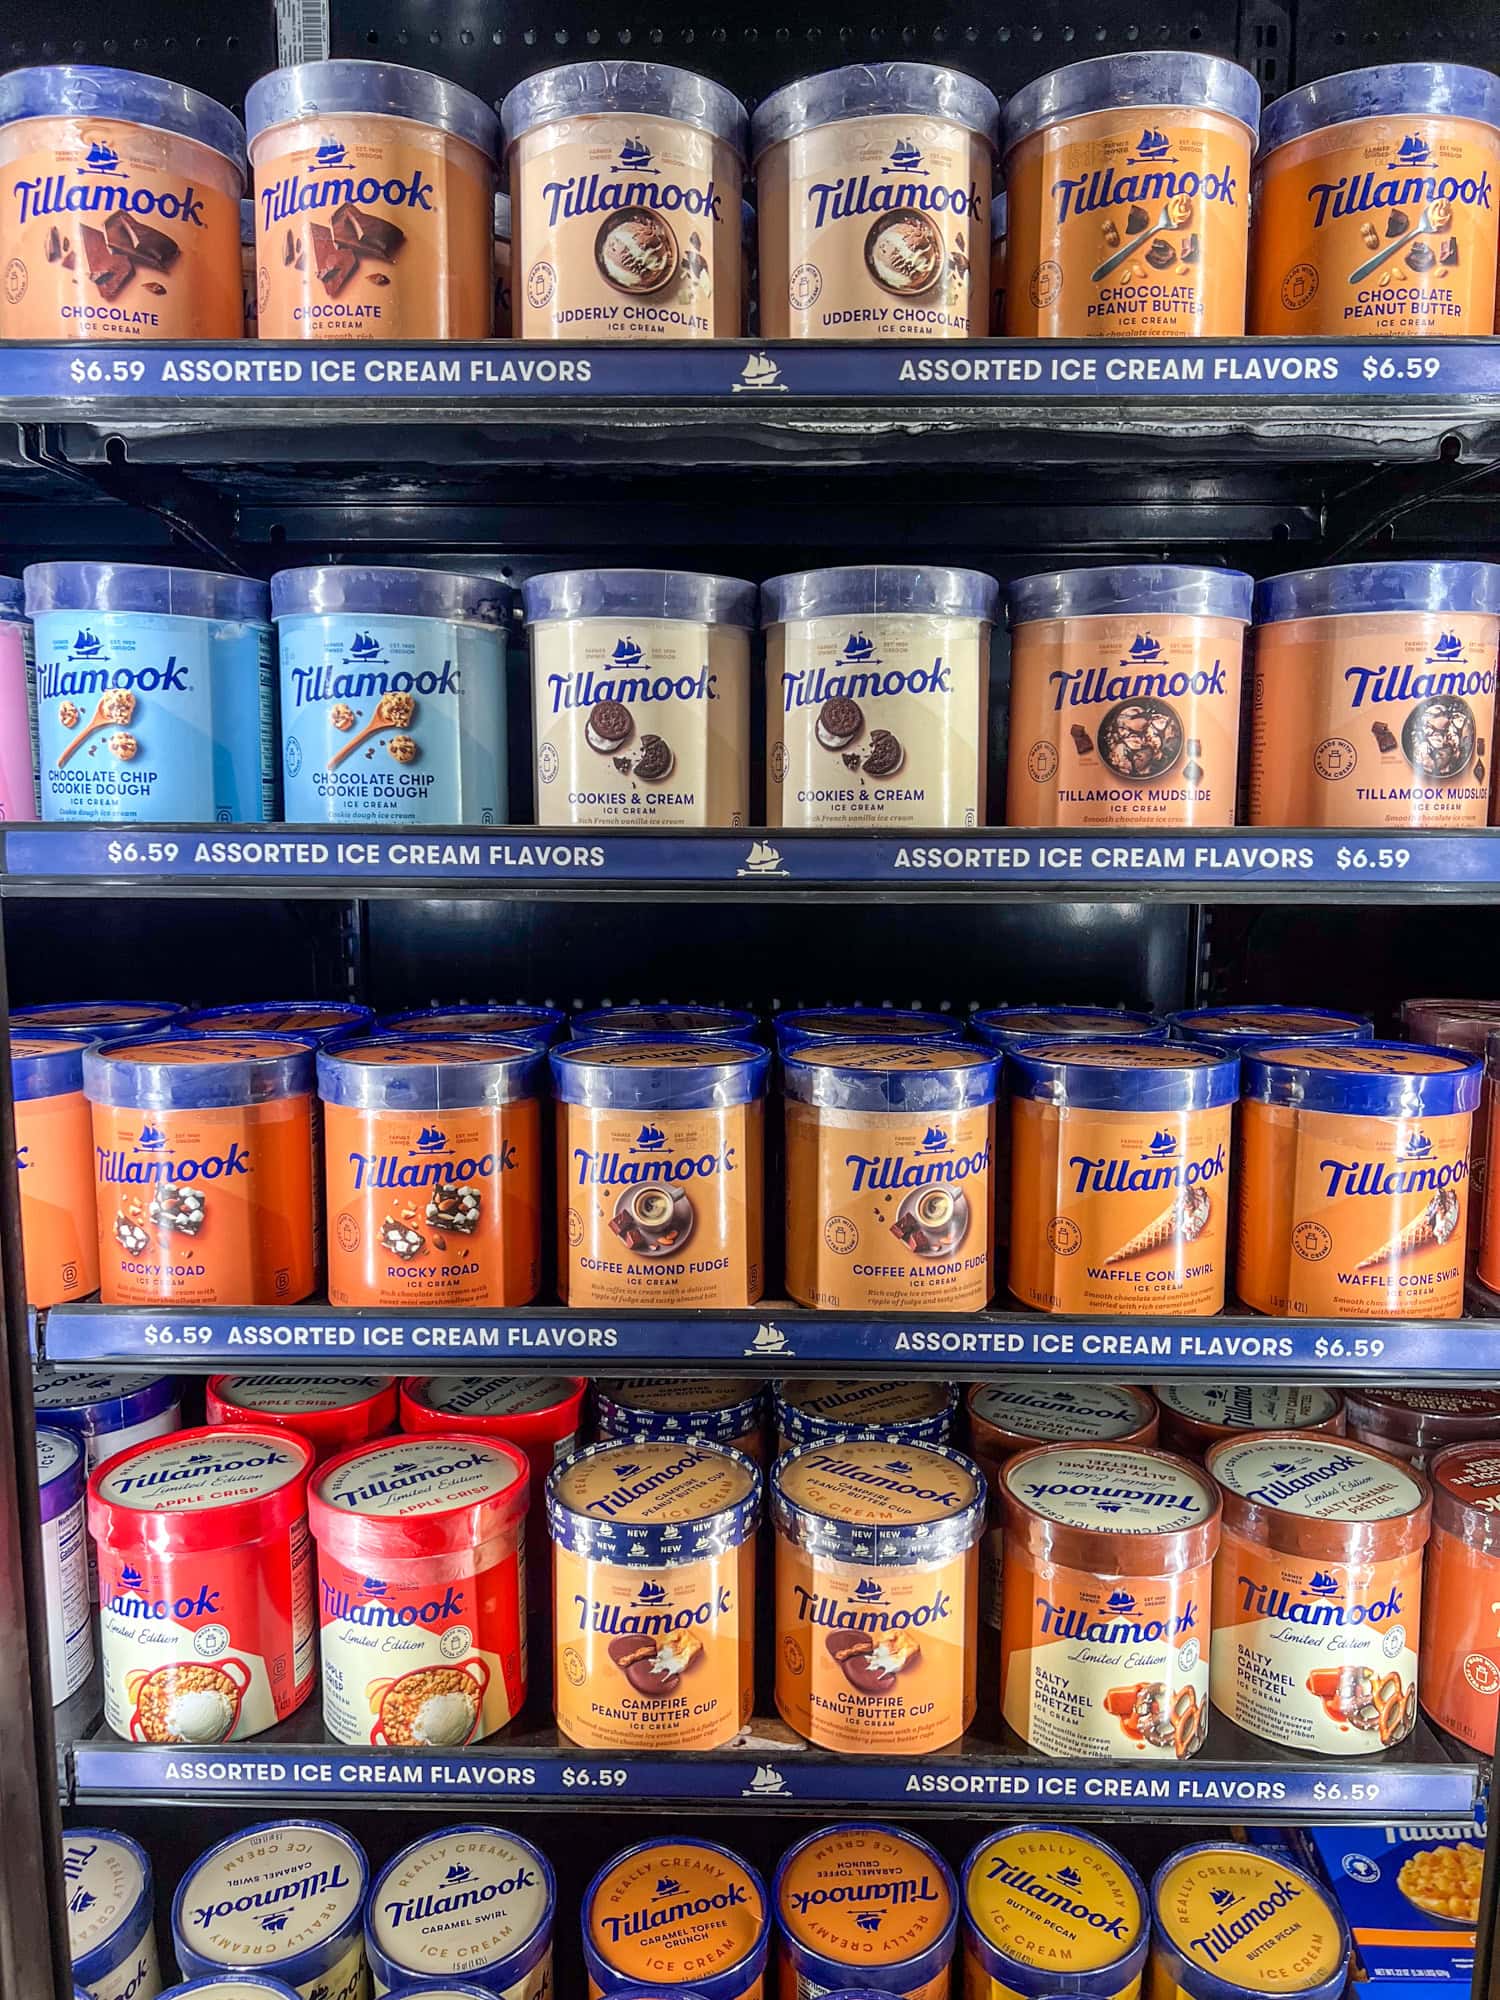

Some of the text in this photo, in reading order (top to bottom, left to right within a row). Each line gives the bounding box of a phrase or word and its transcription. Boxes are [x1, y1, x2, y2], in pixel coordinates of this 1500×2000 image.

[14, 175, 205, 226] Tillamook
[262, 170, 434, 231] Tillamook
[543, 174, 722, 227] Tillamook
[808, 175, 981, 228] Tillamook
[1052, 166, 1237, 224] Tillamook
[1308, 171, 1491, 228] Tillamook
[1088, 300, 1205, 316] PEANUT BUTTER
[1101, 287, 1195, 301] CHOCOLATE
[61, 305, 159, 327] CHOCOLATE
[293, 305, 381, 320] CHOCOLATE
[555, 306, 709, 330] UDDERLY CHOCOLATE
[1141, 316, 1177, 325] CREAM
[80, 323, 141, 335] ICE CREAM
[608, 323, 665, 334] ICE CREAM
[70, 359, 592, 384] $6.59 ASSORTED ICE CREAM FLAVORS
[898, 355, 1441, 382] ASSORTED ICE CREAM FLAVORS $6.59
[292, 661, 462, 706] Tillamook
[548, 665, 718, 712] Tillamook
[782, 658, 952, 712] Tillamook
[1049, 660, 1227, 710] Tillamook
[312, 773, 435, 786] CHOCOLATE CHIP
[317, 785, 428, 799] COOKIE DOUGH
[569, 792, 695, 806] COOKIES & CREAM
[1058, 790, 1212, 802] TILLAMOOK MUDSLIDE
[108, 843, 605, 868] $6.59 ASSORTED ICE CREAM FLAVORS
[894, 848, 1411, 870] ASSORTED ICE CREAM FLAVORS $6.59
[96, 1142, 250, 1185] Tillamook
[349, 1142, 516, 1190] Tillamook
[574, 1140, 735, 1185] Tillamook
[1070, 1144, 1225, 1192] Tillamook
[387, 1263, 480, 1278] ROCKY ROAD
[580, 1256, 730, 1275] COFFEE ALMOND FUDGE
[1338, 1268, 1461, 1287] WAFFLE CONE SWIRL
[427, 1279, 460, 1288] CREAM
[144, 1326, 618, 1348] $6.59 ASSORTED ICE CREAM FLAVORS
[894, 1332, 1385, 1358] ASSORTED ICE CREAM FLAVORS $6.59
[987, 1389, 1138, 1422] Tillamook
[111, 1450, 291, 1494] Tillamook
[141, 1471, 264, 1500] Limited Edition
[333, 1451, 496, 1507] Tillamook
[586, 1450, 706, 1517] Tillamook
[805, 1455, 962, 1508] Tillamook
[1246, 1453, 1364, 1506] Tillamook
[154, 1488, 260, 1509] APPLE CRISP
[400, 1485, 490, 1515] APPLE CRISP
[807, 1477, 913, 1515] PEANUT BUTTER CUP
[838, 1480, 891, 1503] CAMPFIRE
[1024, 1483, 1200, 1513] Tillamook
[1304, 1474, 1375, 1507] Limited Edition
[1316, 1483, 1399, 1519] SALTY CARAMEL
[1346, 1494, 1393, 1515] PRETZEL
[627, 1529, 648, 1538] NEW
[321, 1578, 464, 1628] Tillamook
[574, 1586, 730, 1635] Tillamook
[795, 1590, 952, 1632] Tillamook
[1238, 1575, 1405, 1627] Tillamook
[1036, 1598, 1199, 1646] Tillamook
[339, 1629, 425, 1652] Limited Edition
[1270, 1627, 1372, 1650] Limited Edition
[1238, 1645, 1272, 1665] SALTY
[1237, 1666, 1287, 1696] PRETZEL
[1238, 1654, 1296, 1687] CARAMEL
[591, 1699, 717, 1722] PEANUT BUTTER CUP
[622, 1697, 688, 1709] CAMPFIRE
[165, 1762, 628, 1787] ASSORTED ICE CREAM FLAVORS $6.59
[905, 1774, 1380, 1801] ASSORTED ICE CREAM FLAVORS $6.59
[816, 1866, 903, 1878] CARAMEL TOFFEE
[836, 1860, 880, 1868] CRUNCH
[192, 1864, 350, 1928] Tillamook
[384, 1868, 535, 1928] Tillamook
[791, 1880, 938, 1907] Tillamook
[985, 1856, 1129, 1941] Tillamook
[421, 1910, 508, 1936] CARAMEL SWIRL
[602, 1883, 748, 1942] Tillamook
[1006, 1898, 1078, 1942] BUTTER PECAN
[1190, 1879, 1302, 1964] Tillamook
[640, 1920, 729, 1947] CARAMEL TOFFEE
[664, 1932, 710, 1950] CRUNCH
[1246, 1922, 1303, 1960] BUTTER PECAN
